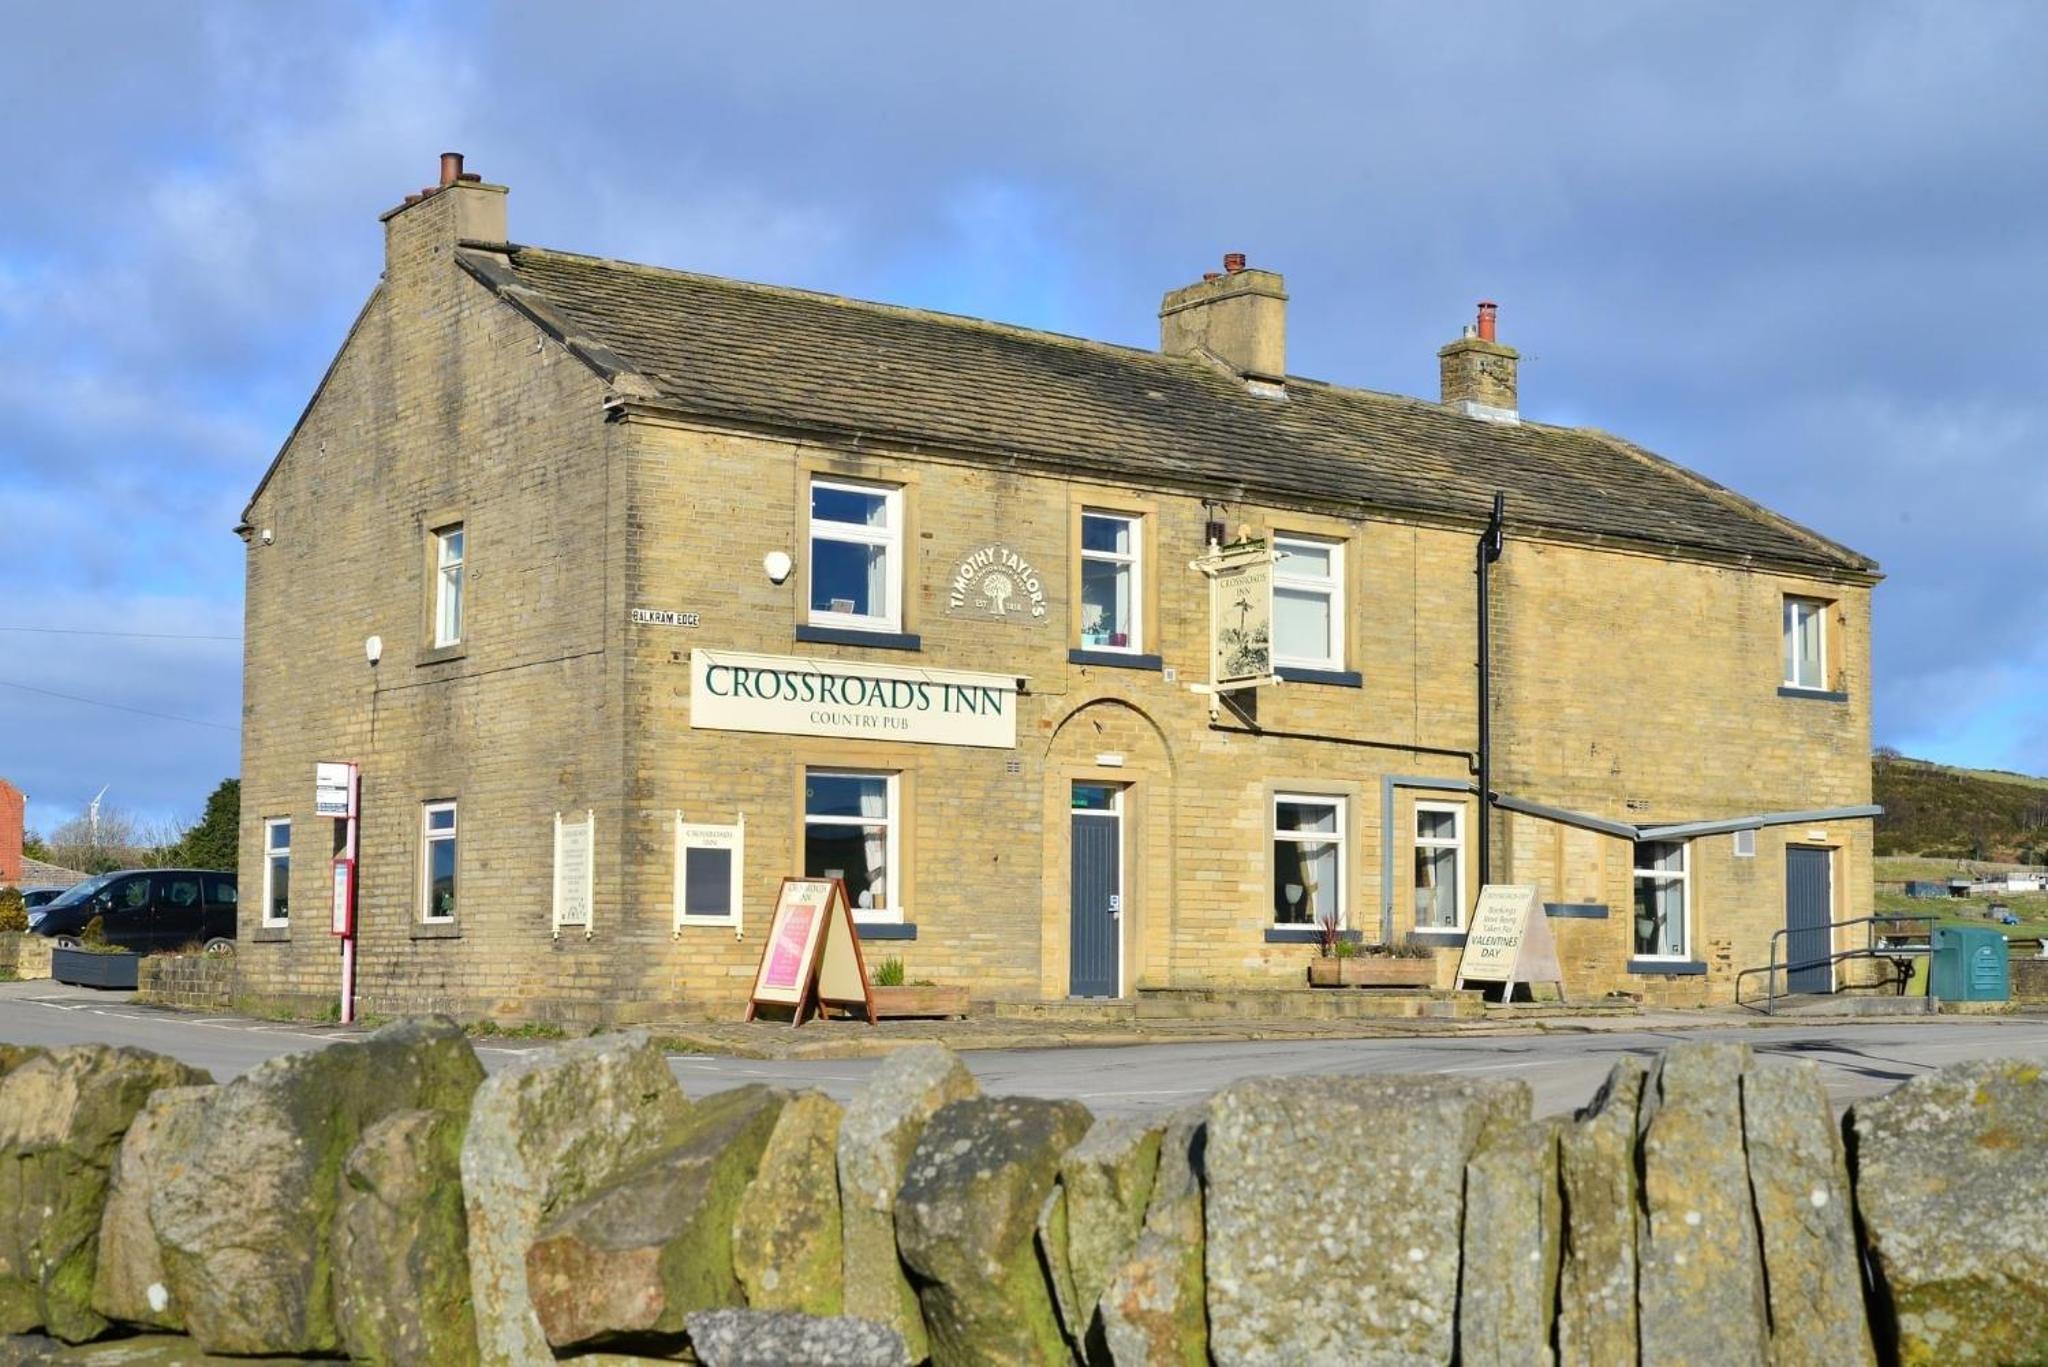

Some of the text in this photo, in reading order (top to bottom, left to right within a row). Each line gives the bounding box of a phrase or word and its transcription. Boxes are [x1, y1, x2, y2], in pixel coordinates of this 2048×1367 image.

[951, 547, 1046, 617] TIMOTHY TAYLOR'S
[633, 610, 674, 624] BALKRAM
[706, 664, 1002, 715] CROSSROADS INN
[810, 711, 909, 730] COUNTRY PUB
[1472, 935, 1519, 947] VALENTINES
[1481, 948, 1501, 958] DAY
